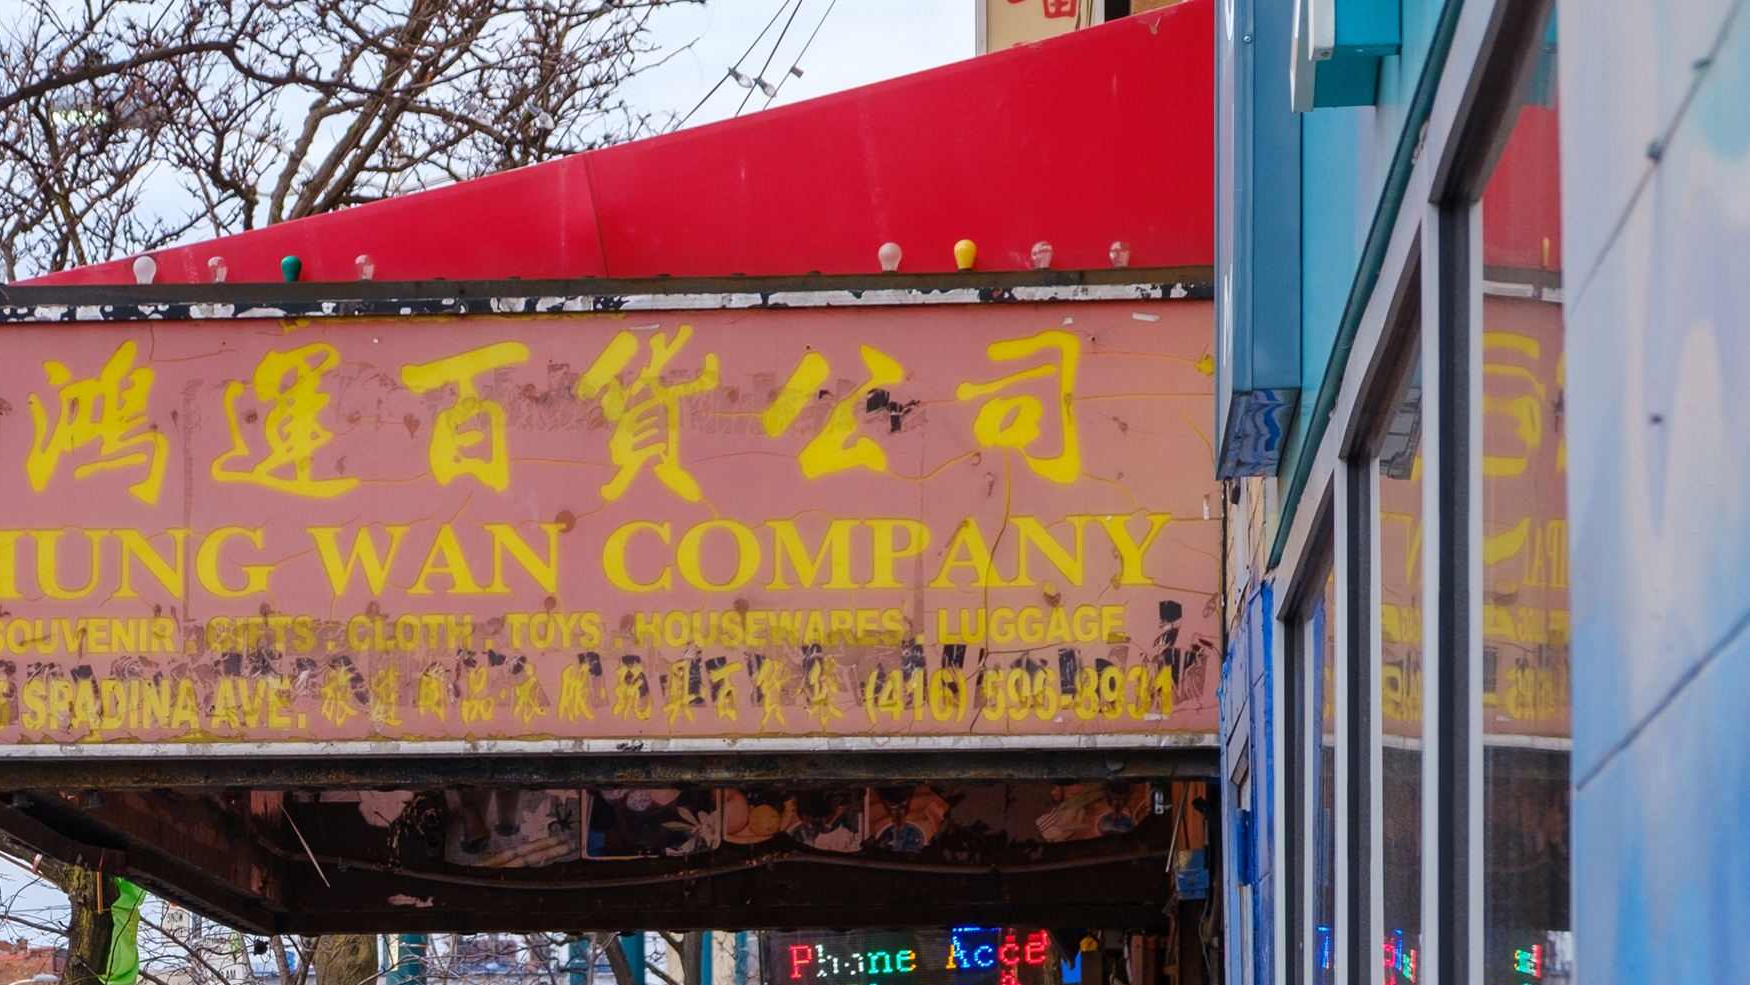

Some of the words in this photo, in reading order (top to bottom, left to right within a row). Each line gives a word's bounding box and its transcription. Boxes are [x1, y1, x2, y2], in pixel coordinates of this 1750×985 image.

[306, 522, 566, 597] WAN
[603, 512, 1171, 593] COMPANY
[206, 615, 316, 653] GIFTS
[347, 613, 472, 652] CLOTH
[506, 611, 601, 650] TOYS
[635, 607, 906, 649] HOUSEWARES
[937, 605, 1126, 645] LUGGAGE
[21, 678, 199, 731] SPADINA
[864, 666, 967, 724] (416)
[982, 665, 1172, 722] 596-8931
[790, 944, 916, 978] Phone
